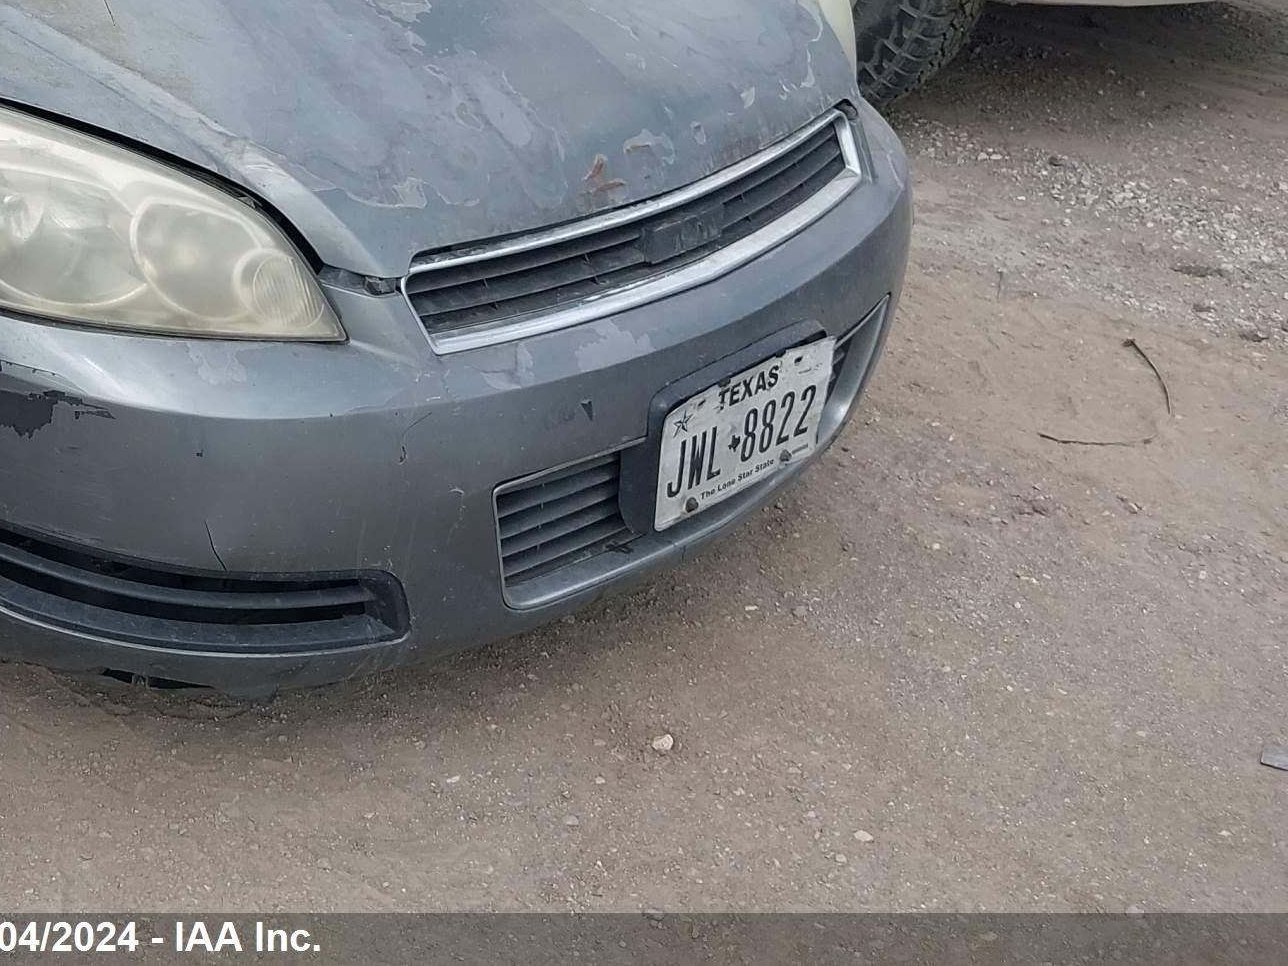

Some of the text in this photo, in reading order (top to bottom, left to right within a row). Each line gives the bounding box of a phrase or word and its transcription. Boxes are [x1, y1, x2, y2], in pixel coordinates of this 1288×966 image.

[718, 364, 781, 407] TEXAS
[666, 384, 817, 498] JWL 8822
[701, 458, 775, 500] The Lone Star State
